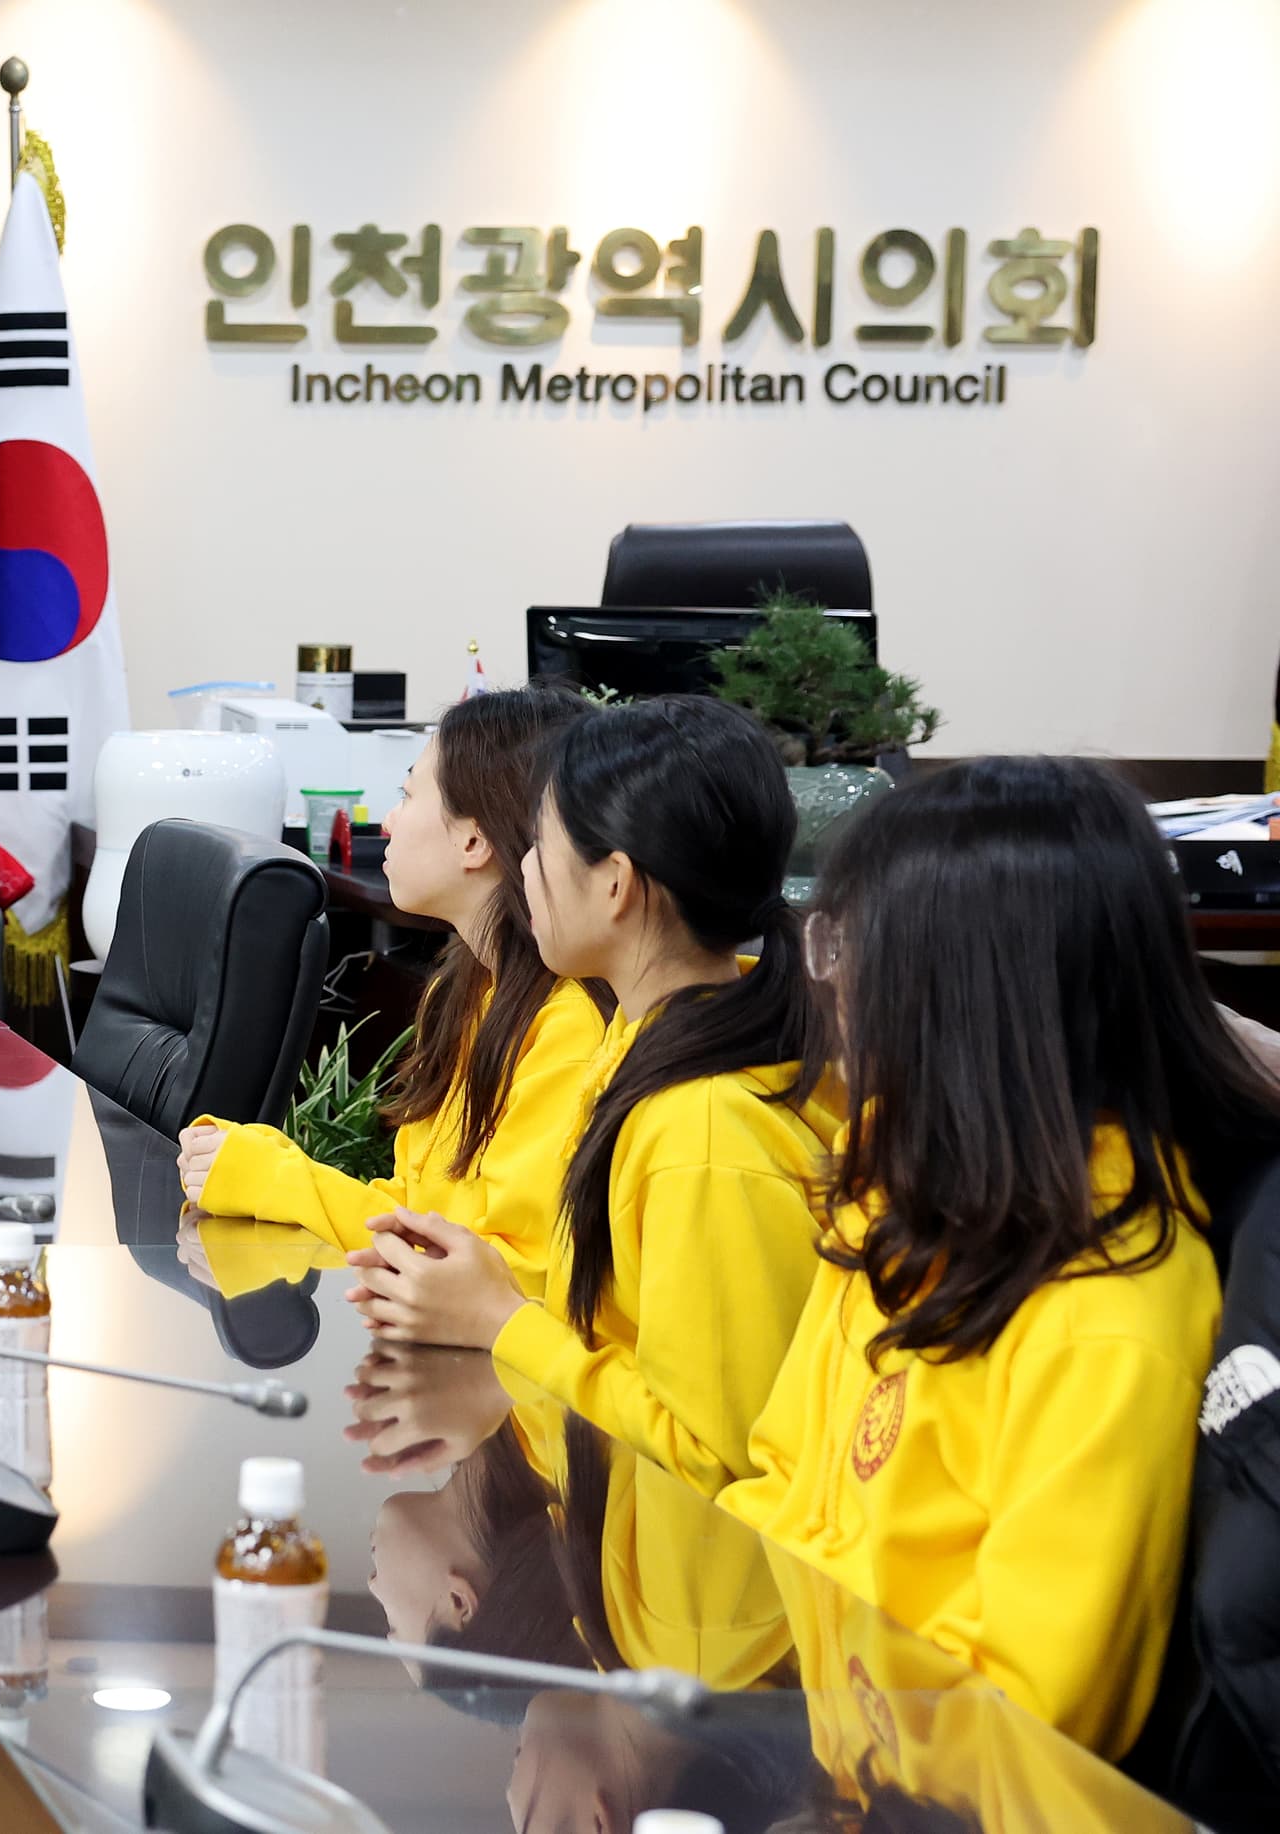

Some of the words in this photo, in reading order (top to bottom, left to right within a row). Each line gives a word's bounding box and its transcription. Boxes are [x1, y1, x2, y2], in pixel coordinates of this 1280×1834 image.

[203, 223, 1100, 348] 인천광역시의회
[291, 363, 481, 403] Incheon
[501, 363, 805, 412] Metropolitan
[824, 362, 1006, 404] Council
